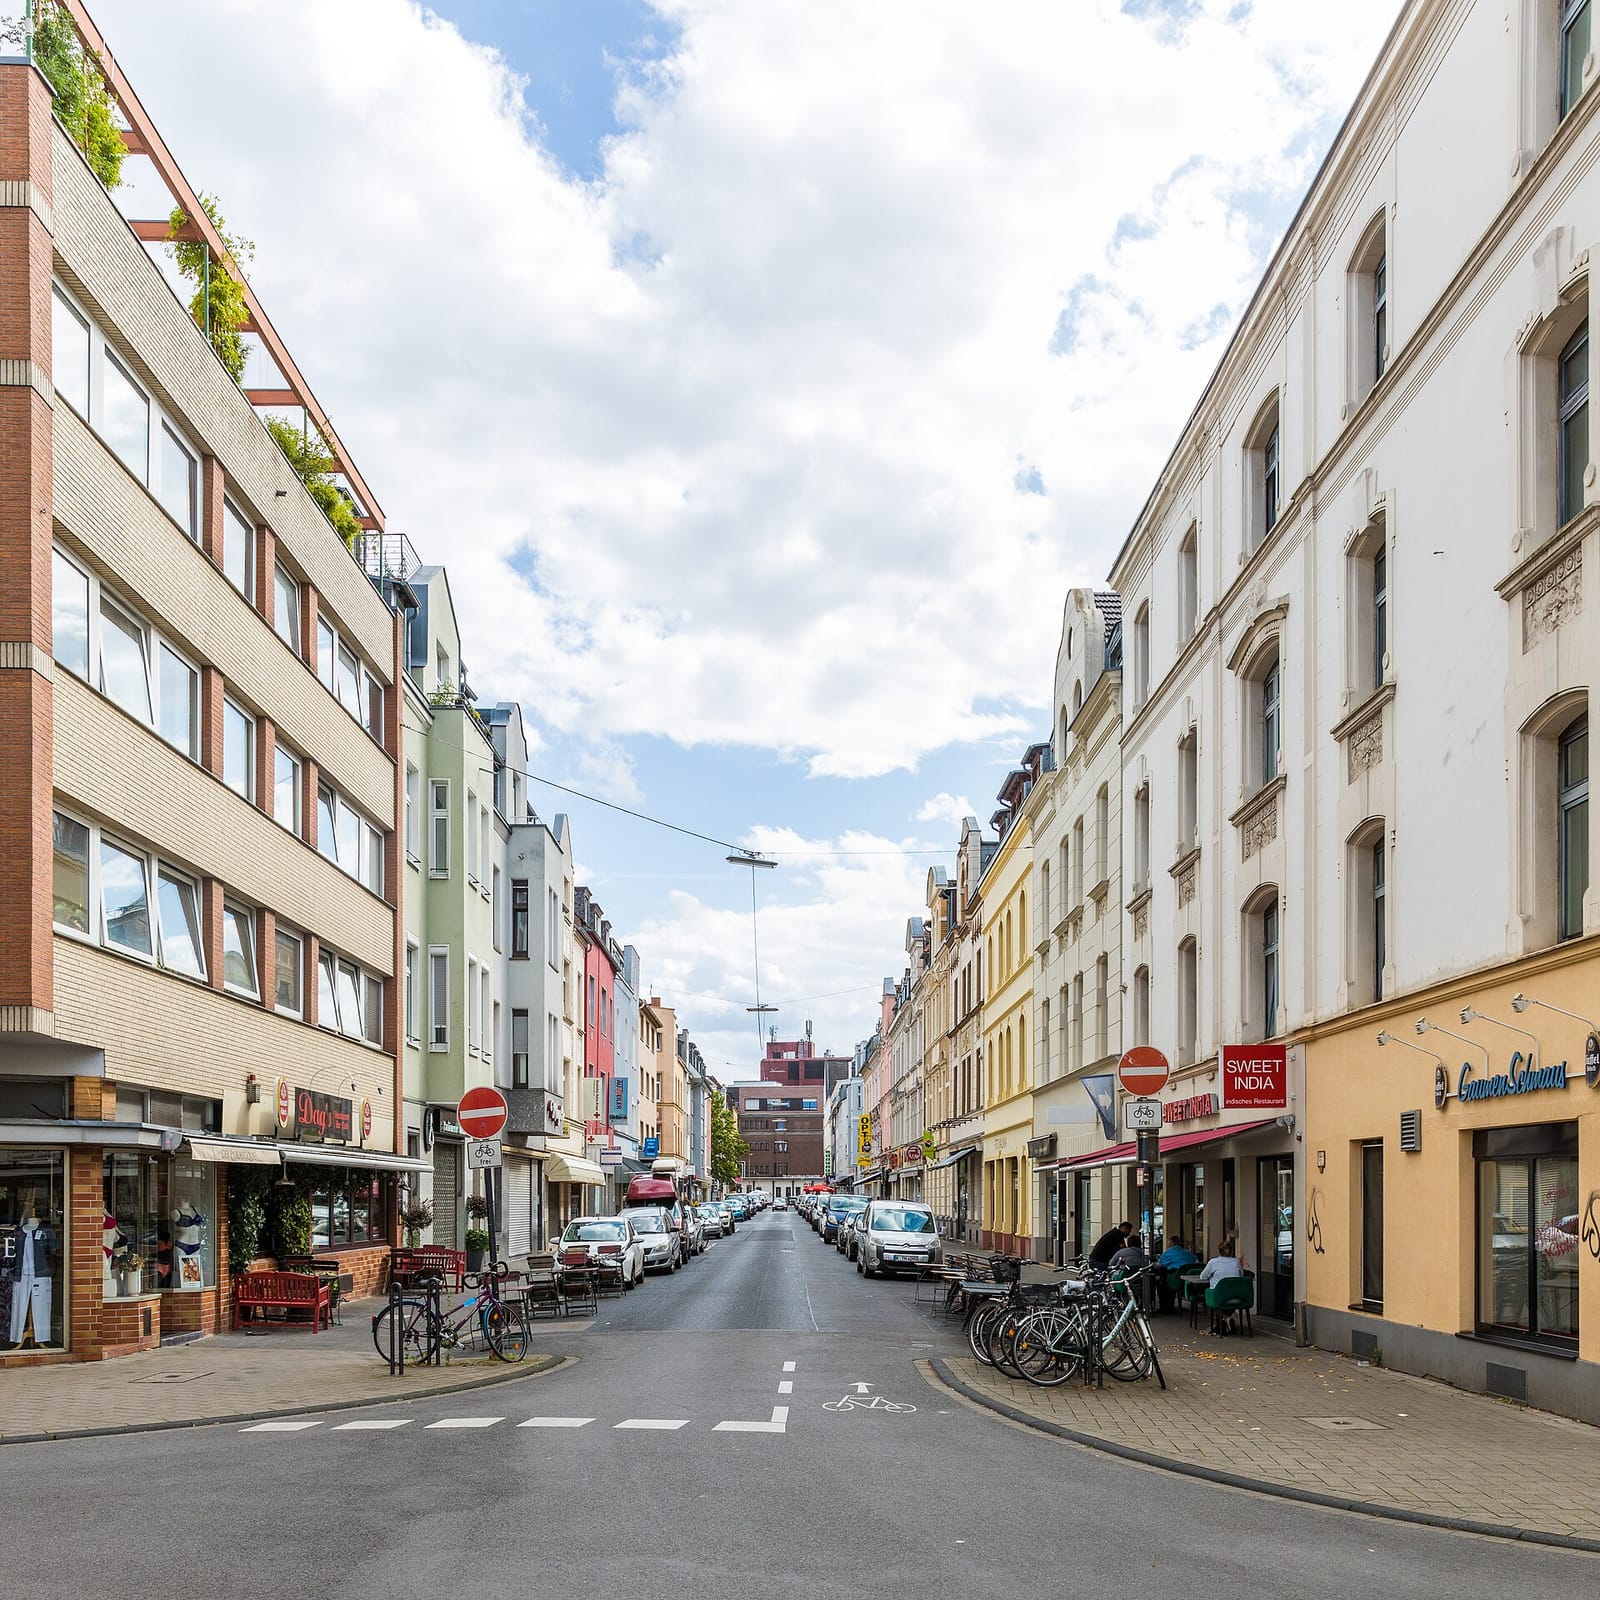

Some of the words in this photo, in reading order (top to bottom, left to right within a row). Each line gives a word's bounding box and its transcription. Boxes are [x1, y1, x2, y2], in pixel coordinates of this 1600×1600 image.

[1226, 1059, 1283, 1074] SWEET
[1458, 1051, 1567, 1102] GaumenSchmaus
[1234, 1076, 1275, 1090] INDIA
[1163, 1099, 1188, 1123] SWEET
[1189, 1093, 1213, 1120] INDIA
[1253, 1097, 1285, 1105] Restaurant
[298, 1092, 332, 1136] Dag's
[3, 1237, 16, 1258] E
